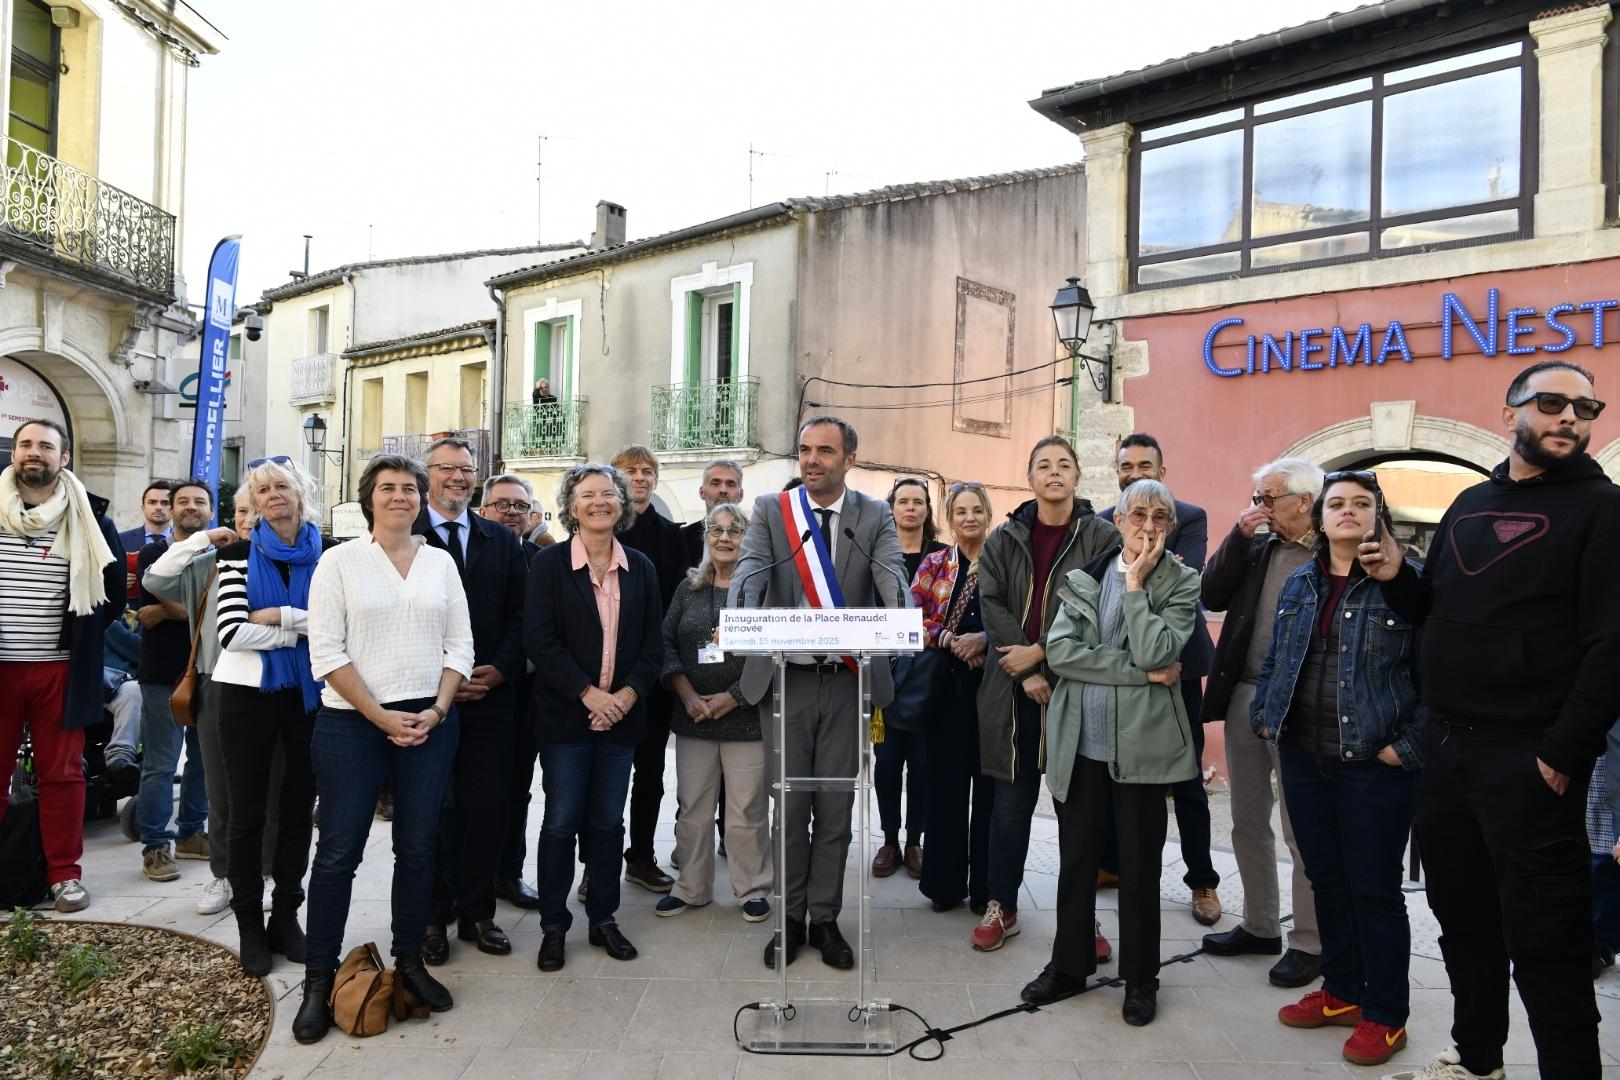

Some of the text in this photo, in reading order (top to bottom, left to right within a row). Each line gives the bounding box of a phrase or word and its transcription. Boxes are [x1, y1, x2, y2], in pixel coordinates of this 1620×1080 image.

[1203, 318, 1413, 377] CINEMA
[724, 613, 887, 624] Inauguration de la Place Renaudel
[724, 624, 763, 632] rénovée
[724, 637, 839, 645] Samedi 15 novembre 2025
